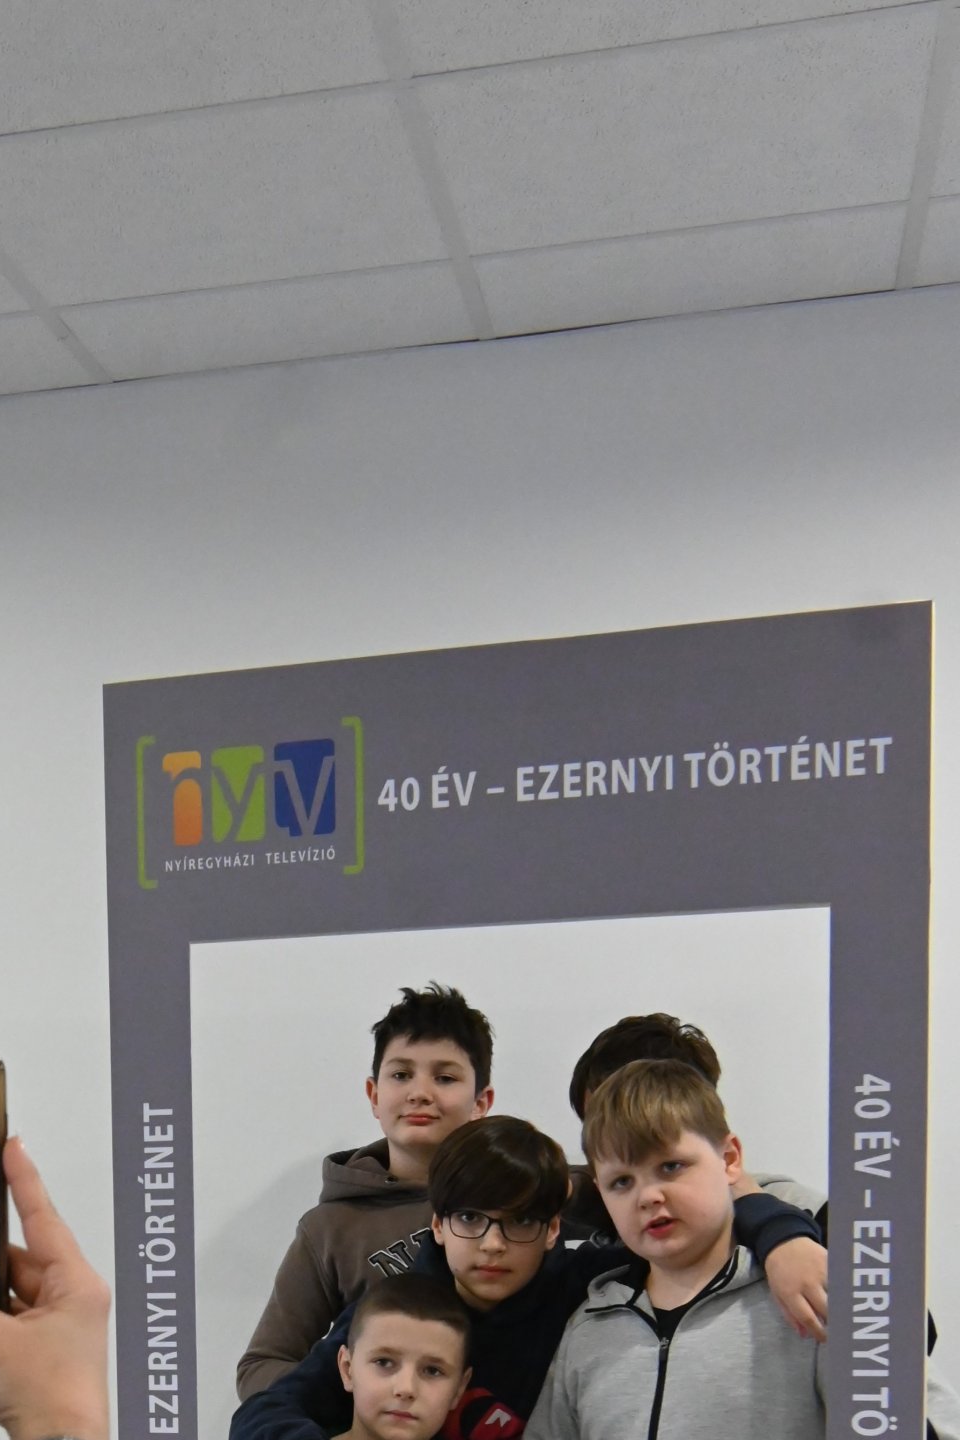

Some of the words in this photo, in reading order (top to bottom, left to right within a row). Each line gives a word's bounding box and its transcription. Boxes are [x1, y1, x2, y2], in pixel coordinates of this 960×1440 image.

[377, 776, 421, 812] 40
[431, 765, 477, 809] ÉV
[516, 754, 674, 802] EZERNYI
[683, 735, 893, 788] TÖRTÉNET
[165, 853, 255, 872] NYÍREGYHÁZI
[266, 845, 336, 865] TELEVÍZIÓ
[854, 1073, 891, 1120] 40
[137, 1102, 177, 1284] TÖRTÉNET
[854, 1131, 900, 1179] ÉV
[852, 1220, 891, 1377] EZERNYI
[146, 1292, 180, 1434] EZERNYI
